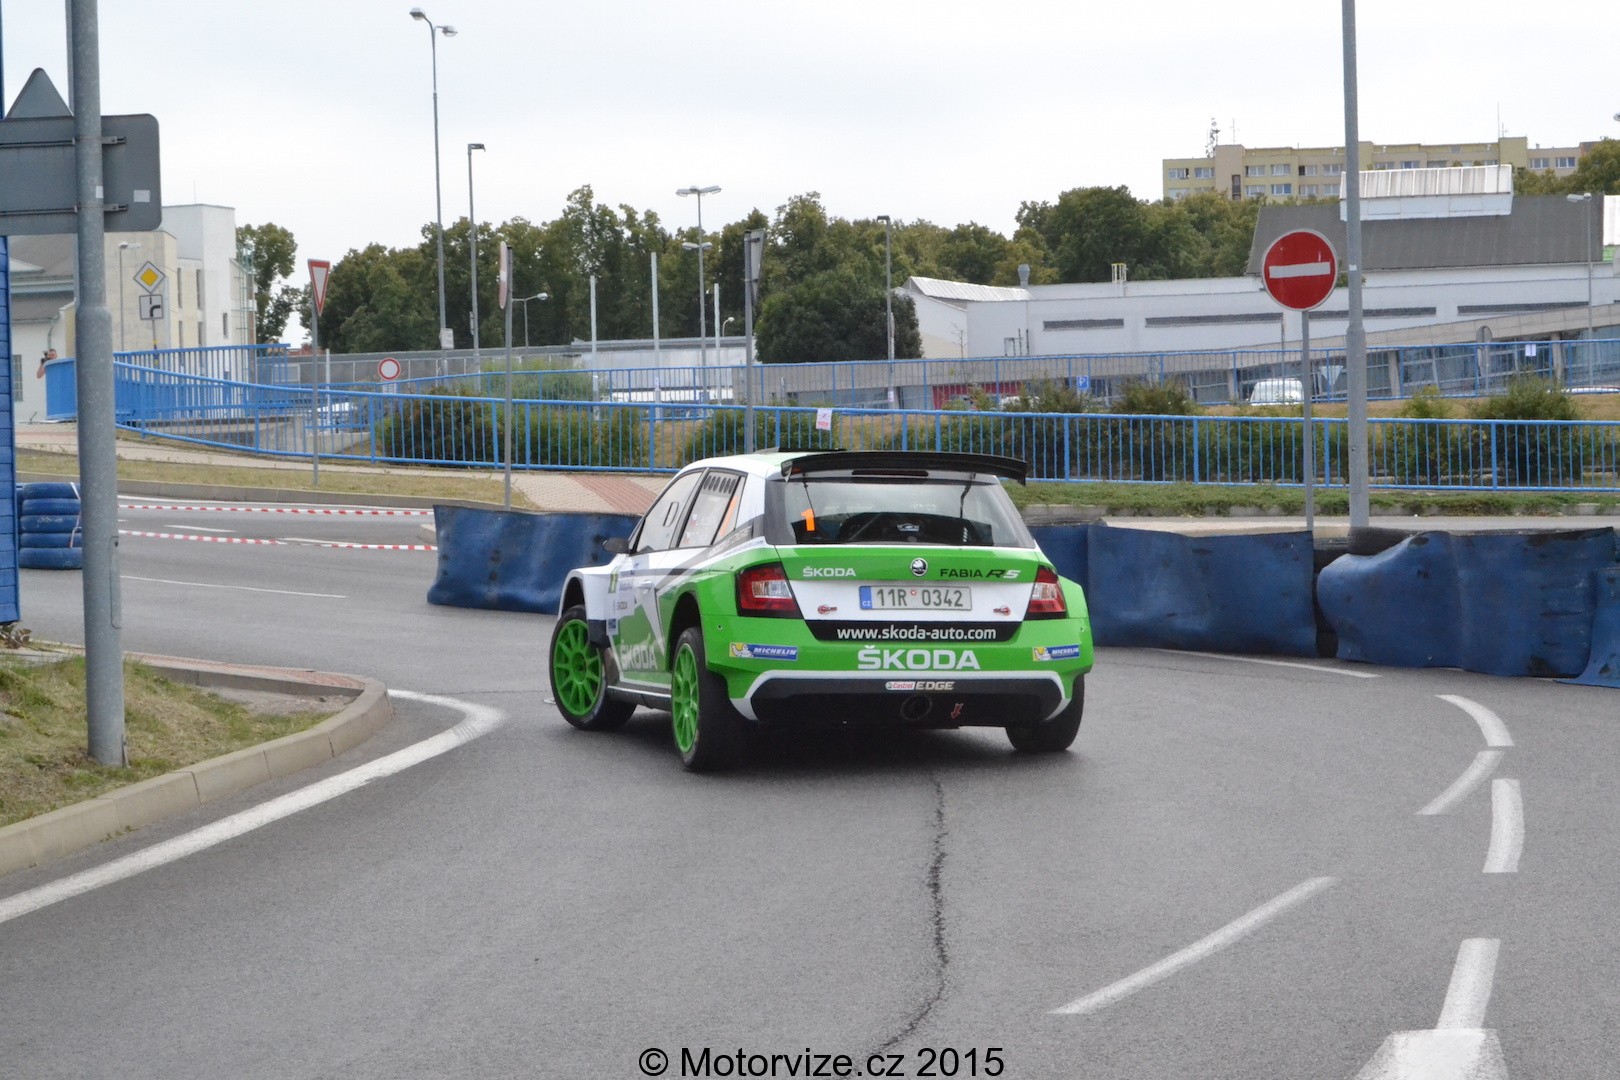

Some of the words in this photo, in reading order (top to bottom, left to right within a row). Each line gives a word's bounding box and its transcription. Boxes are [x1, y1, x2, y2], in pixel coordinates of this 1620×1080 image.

[801, 508, 816, 532] 1
[802, 565, 857, 577] ŠKODA
[939, 568, 983, 578] FABIA
[876, 588, 908, 607] 11R
[922, 589, 963, 607] 0342
[837, 625, 996, 641] www.skoda-auto.com
[753, 647, 797, 656] MICHELIN
[857, 644, 981, 670] ŠKODA
[891, 681, 914, 690] Castrol
[914, 681, 955, 691] EDGE
